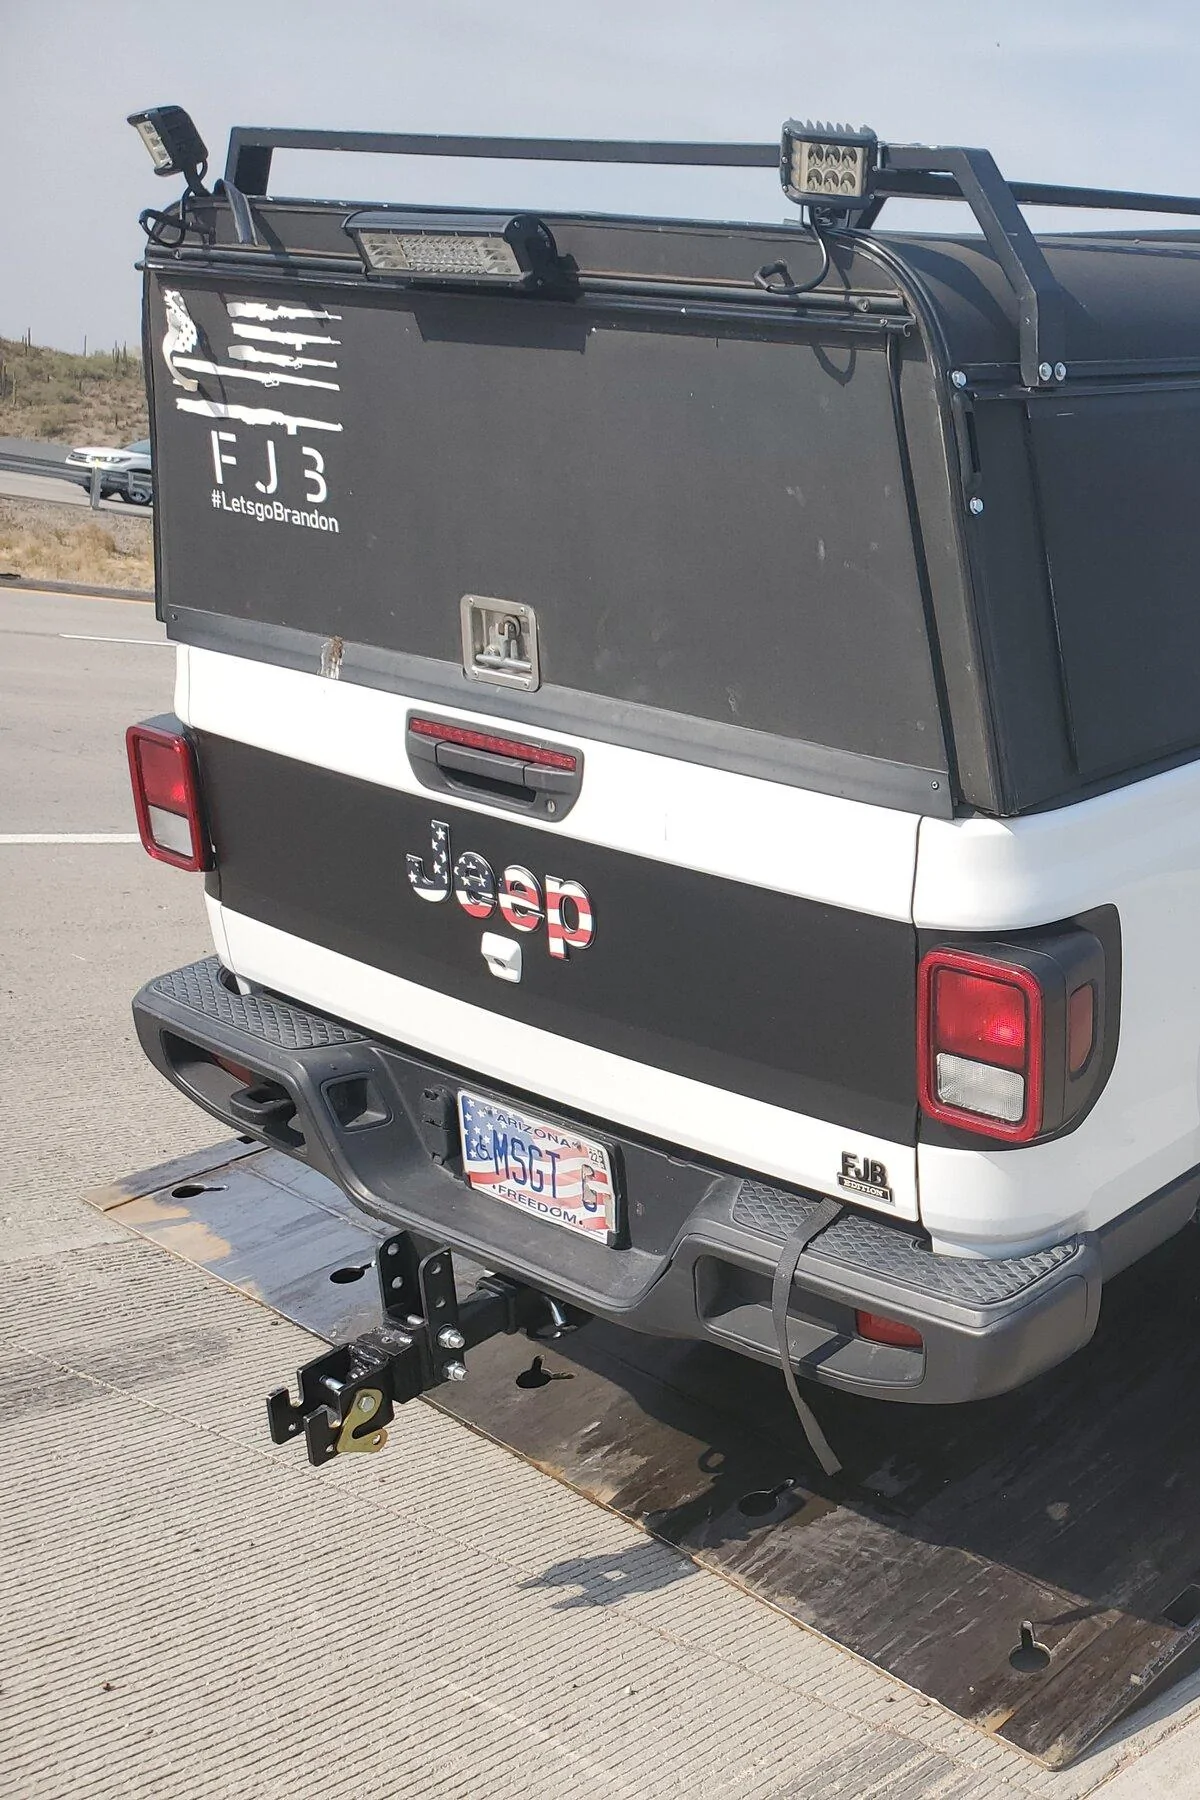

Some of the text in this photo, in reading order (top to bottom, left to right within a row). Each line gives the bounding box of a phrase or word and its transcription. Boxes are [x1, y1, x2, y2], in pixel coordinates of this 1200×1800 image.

[211, 488, 340, 534] #LetsgoBrandon
[406, 819, 597, 962] Jeep
[497, 1113, 572, 1149] ARIZONA
[493, 1129, 561, 1199] MSGT
[841, 1150, 887, 1188] FJB
[498, 1184, 578, 1225] FREEDOM
[843, 1178, 884, 1197] EDITION
